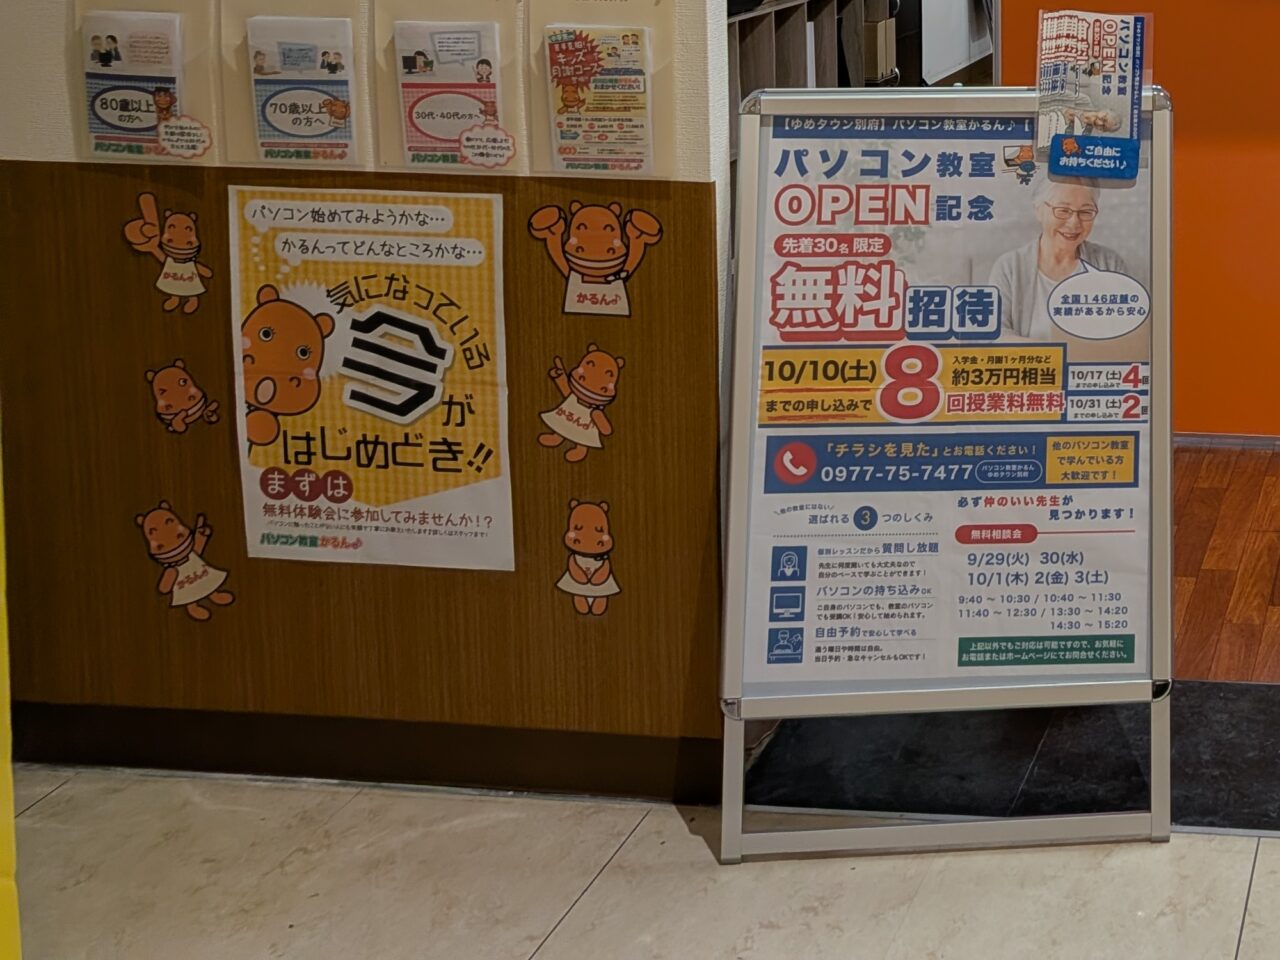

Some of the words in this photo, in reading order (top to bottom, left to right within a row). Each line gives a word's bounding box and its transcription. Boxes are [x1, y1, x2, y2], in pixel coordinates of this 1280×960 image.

[1102, 18, 1118, 74] OPEN
[100, 98, 155, 113] 80歳以上
[270, 102, 327, 114] 70歳以上
[292, 117, 325, 126] の方へ
[1085, 145, 1121, 157] ご自由に
[774, 148, 996, 179] パソコン教室
[774, 184, 931, 227] OPEN
[935, 195, 995, 222] 記念
[771, 261, 907, 332] 無料
[908, 288, 995, 330] 招待
[1053, 306, 1147, 317] 実績があるから安心
[326, 273, 491, 370] 気になっている
[764, 359, 877, 384] 10/10(土)
[952, 367, 1056, 386] 約3万円相当
[880, 344, 941, 420] 8
[442, 393, 475, 427] が
[766, 399, 873, 413] までの申し込みで
[946, 390, 1066, 413] 回授業料無料
[1052, 440, 1129, 450] 他のパソコン教室
[1057, 455, 1124, 465] で学んでいる方
[821, 464, 974, 482] 0977-75-7477
[267, 471, 348, 499] まずは
[958, 495, 1074, 508] 必ず仲のいい先生が
[971, 529, 1022, 540] 無料相談会
[967, 552, 1030, 568] 9/29(火)
[1040, 551, 1084, 566] 30(水)
[968, 572, 1029, 587] 10/1(木)
[1035, 571, 1069, 586] 2(金)
[1074, 570, 1109, 585] 3(土)
[958, 596, 982, 604] 9:40
[1000, 595, 1030, 603] 10:30
[1044, 594, 1074, 603] 10:40
[1091, 593, 1121, 601] 11:30
[958, 609, 989, 618] 11:40
[1006, 608, 1037, 617] 12:30
[1050, 607, 1081, 616] 13:30
[1098, 606, 1128, 615] 14:20
[1050, 621, 1081, 630] 14:30
[1098, 620, 1128, 629] 15:20
